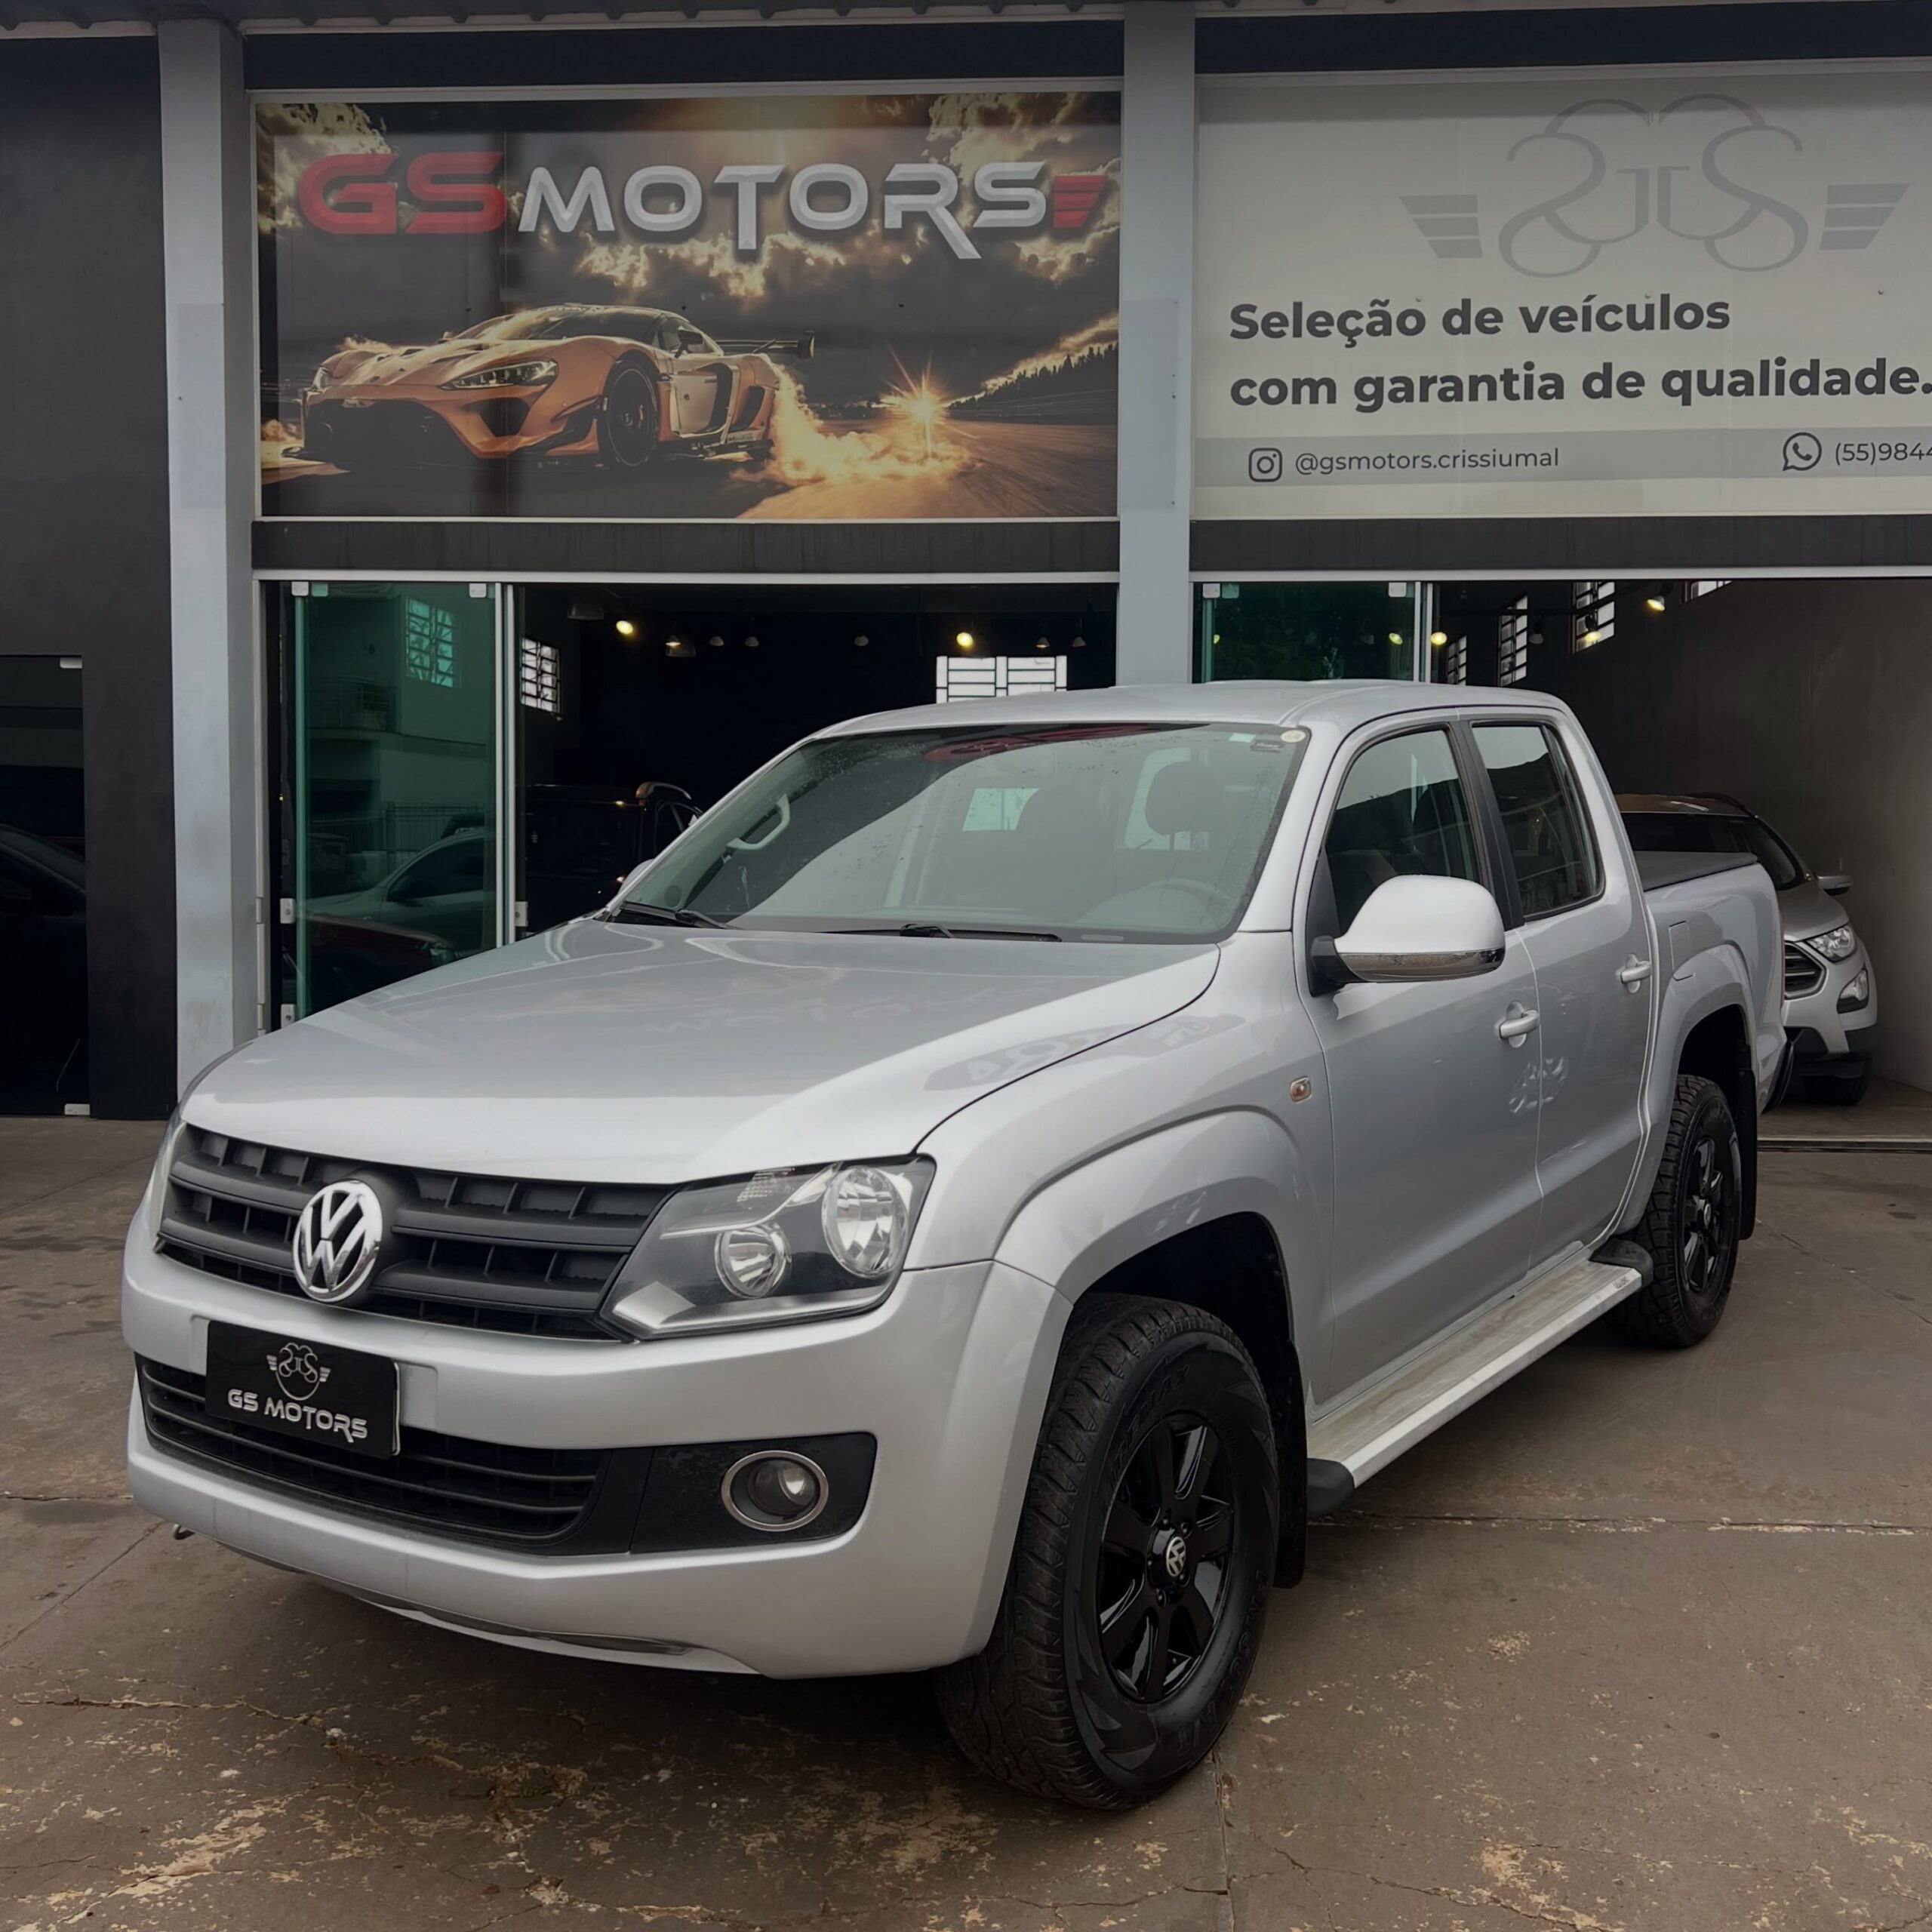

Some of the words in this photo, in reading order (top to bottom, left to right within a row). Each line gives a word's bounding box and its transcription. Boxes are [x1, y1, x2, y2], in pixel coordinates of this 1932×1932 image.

[1229, 298, 1426, 349] Seleção
[1441, 298, 1504, 336] de
[1518, 293, 1730, 334] veículos
[1230, 376, 1337, 406] com
[1354, 361, 1564, 414] garantia
[1582, 361, 1646, 400] de
[1661, 355, 1932, 407] qualidade.
[1295, 447, 1559, 475] @gsmotors.crissiumal
[227, 1388, 259, 1413] GS
[263, 1396, 368, 1443] MOTORS
